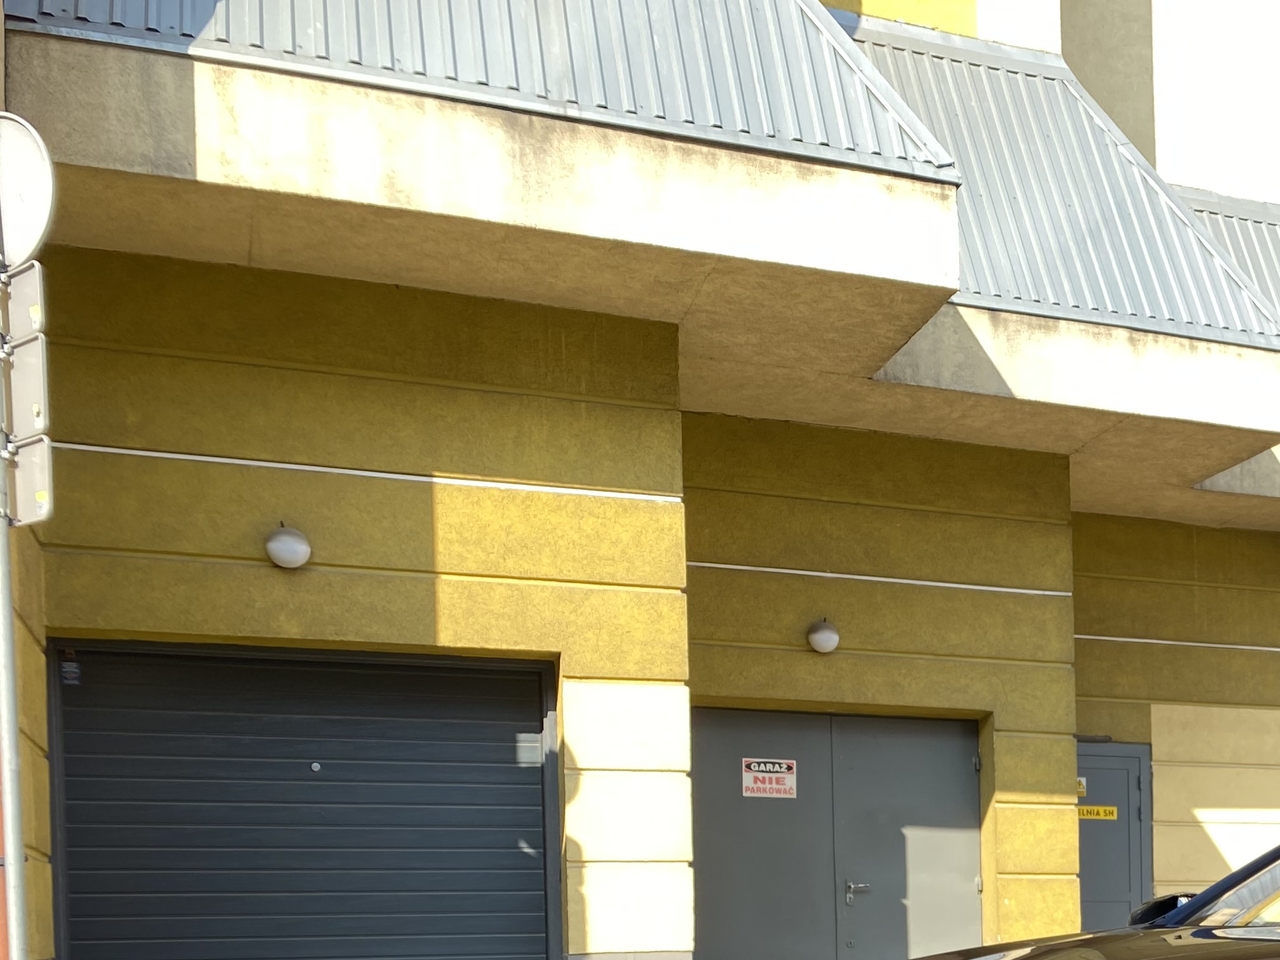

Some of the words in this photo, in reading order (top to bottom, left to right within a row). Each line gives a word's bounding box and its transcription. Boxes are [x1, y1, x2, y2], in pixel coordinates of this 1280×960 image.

[750, 762, 788, 772] GARAŻ
[753, 775, 786, 786] NIE
[744, 786, 794, 795] PARKOWAĆ
